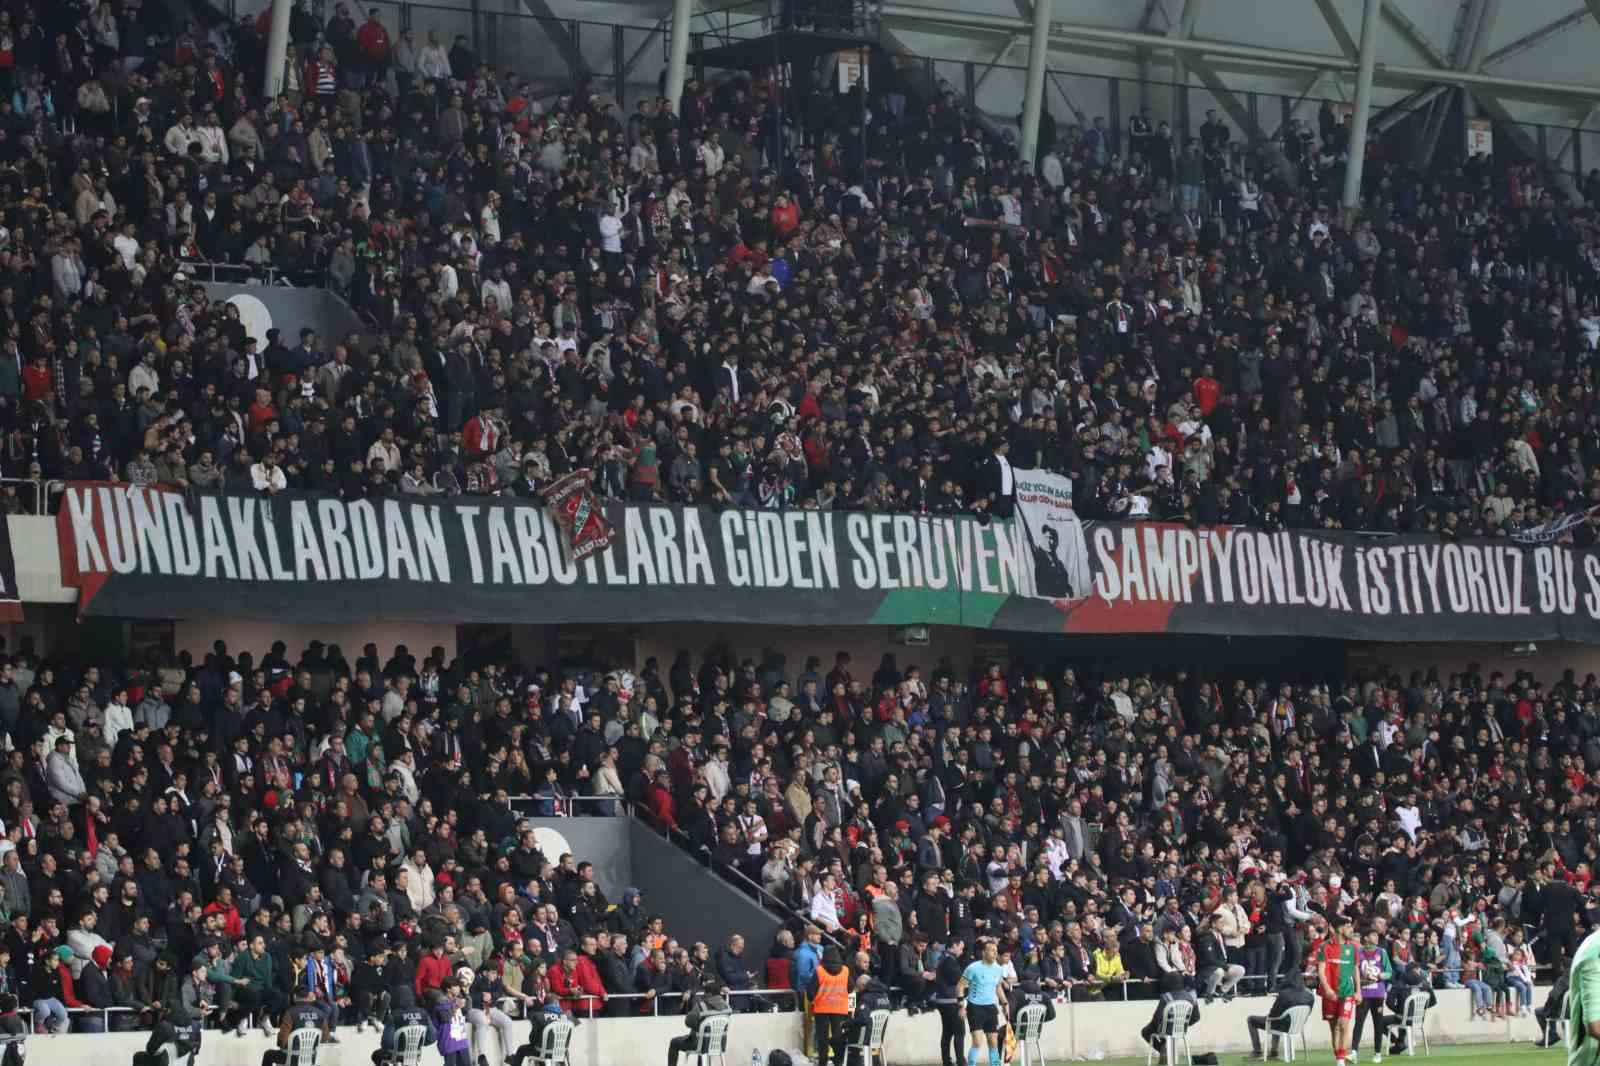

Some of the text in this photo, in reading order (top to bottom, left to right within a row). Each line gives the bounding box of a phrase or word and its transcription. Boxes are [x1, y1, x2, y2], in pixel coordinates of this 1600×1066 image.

[67, 487, 451, 583] KUNDAKLARDAN
[720, 509, 840, 588] GİDEN
[1093, 526, 1352, 612] ŞAMPİYONLUK
[1355, 543, 1531, 615] İSTİYORUZ
[1534, 545, 1577, 614] BU
